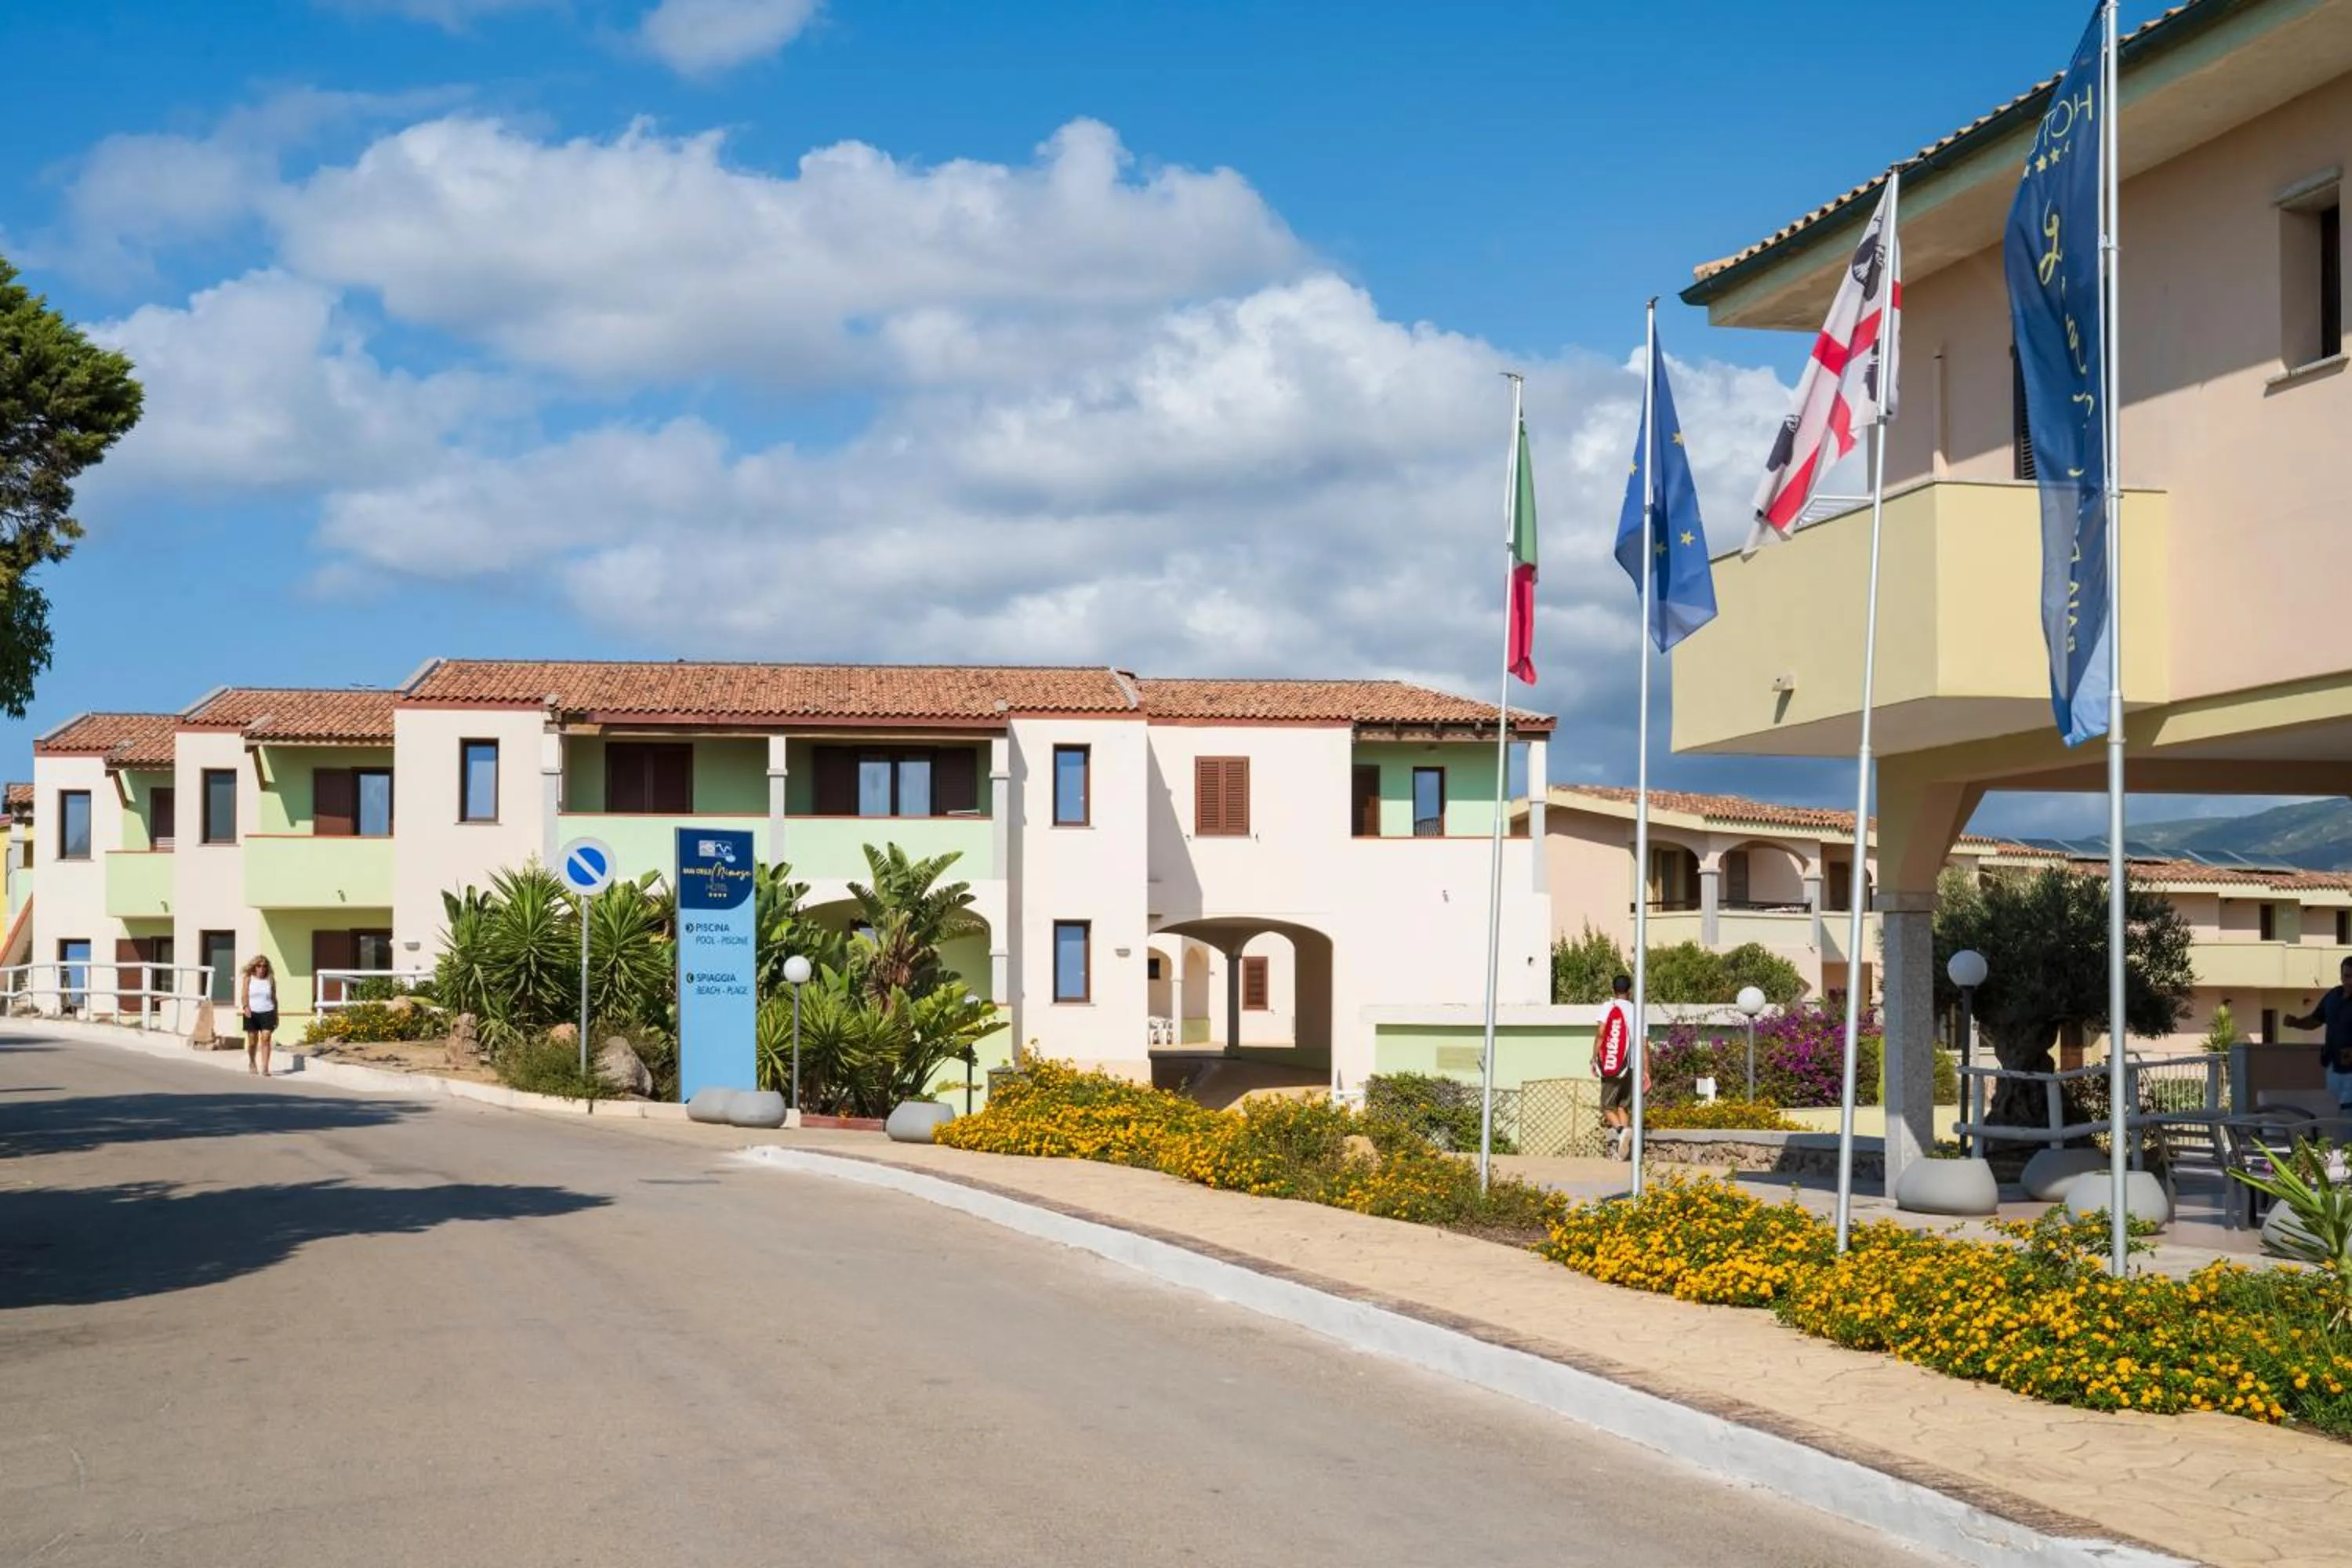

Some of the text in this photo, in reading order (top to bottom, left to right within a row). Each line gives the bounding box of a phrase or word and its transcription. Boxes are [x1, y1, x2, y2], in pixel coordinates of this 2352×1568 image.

[695, 923, 730, 932] PISCINA
[695, 935, 715, 946] POOL
[695, 973, 736, 982] SPIAGGIA
[695, 986, 720, 995] BEACH
[727, 985, 748, 995] PLAGE
[1604, 1018, 1621, 1071] Wilson
